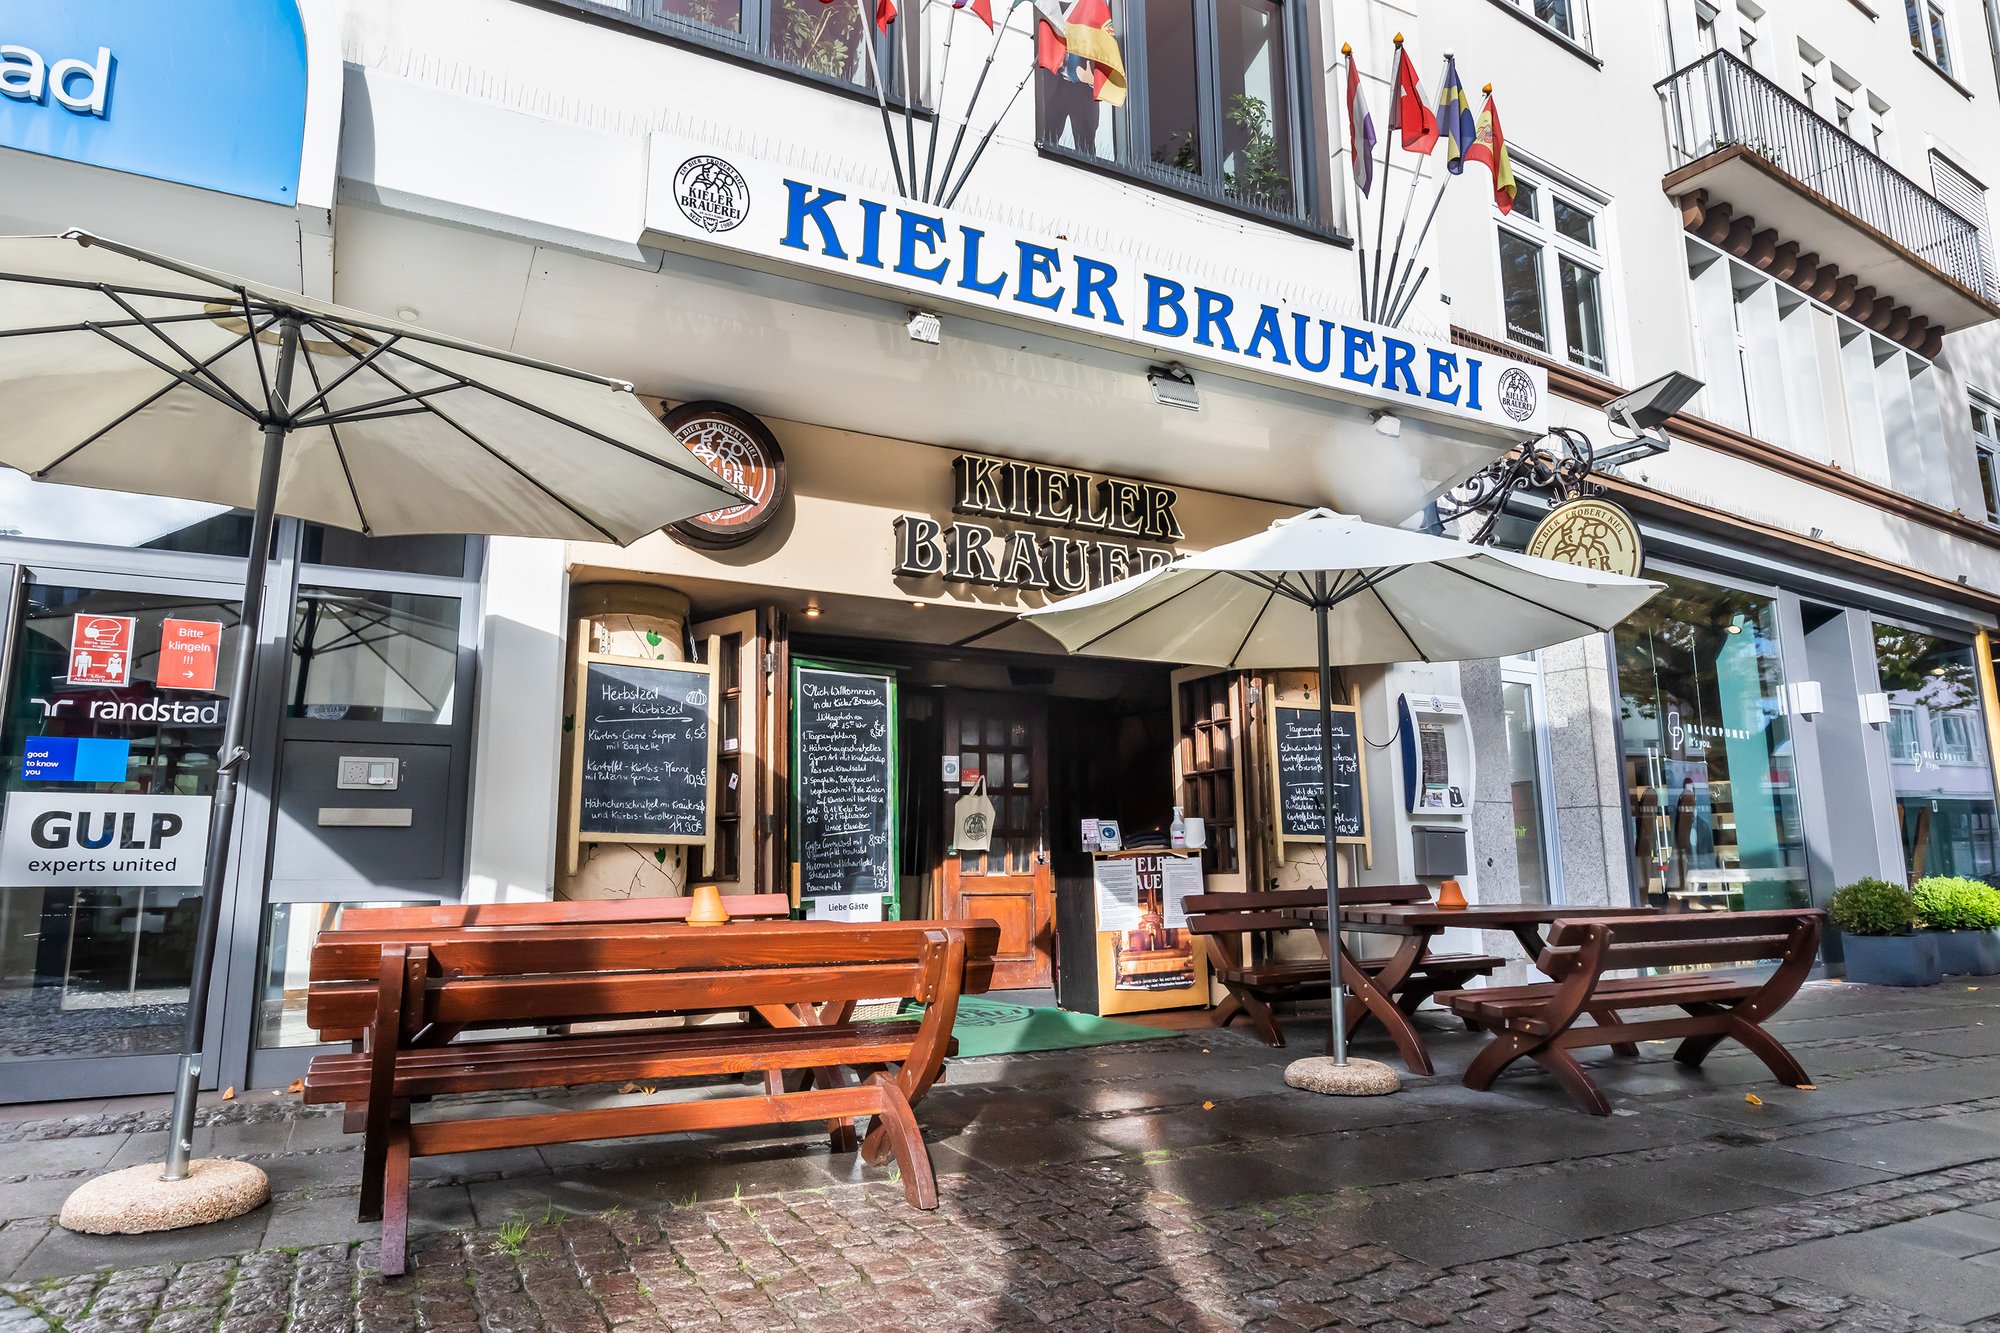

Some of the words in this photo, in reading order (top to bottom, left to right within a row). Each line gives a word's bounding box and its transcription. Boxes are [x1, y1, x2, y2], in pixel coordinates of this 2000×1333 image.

[688, 158, 702, 168] BIER
[734, 174, 745, 189] KIEL
[689, 187, 733, 207] KIELER
[681, 195, 741, 219] BRAUEREI
[689, 212, 701, 223] SEIT
[780, 178, 1125, 327] KIELER
[1142, 273, 1483, 412] BRAUEREI
[1502, 397, 1532, 411] BRAUEREI
[1505, 390, 1528, 403] KIELER
[682, 423, 702, 440] BIER
[744, 440, 758, 459] KIEL
[953, 453, 1186, 543] KIELER
[1533, 541, 1543, 556] EIN
[1542, 519, 1561, 540] BIER
[1607, 515, 1625, 535] KIEL
[179, 627, 204, 638] Bitte
[168, 640, 211, 653] klingeln
[182, 656, 193, 665] !!!
[602, 684, 660, 701] Herbstzeit
[89, 697, 220, 724] randstad
[631, 702, 683, 715] Kürbiszeit
[1687, 723, 1750, 740] BLICKPUNKT
[27, 751, 49, 760] good
[36, 760, 59, 768] know
[25, 769, 41, 777] you
[30, 810, 183, 850] GULP
[28, 858, 106, 876] experts
[112, 857, 177, 872] united
[828, 903, 848, 912] Liebe
[848, 901, 869, 911] Gäste
